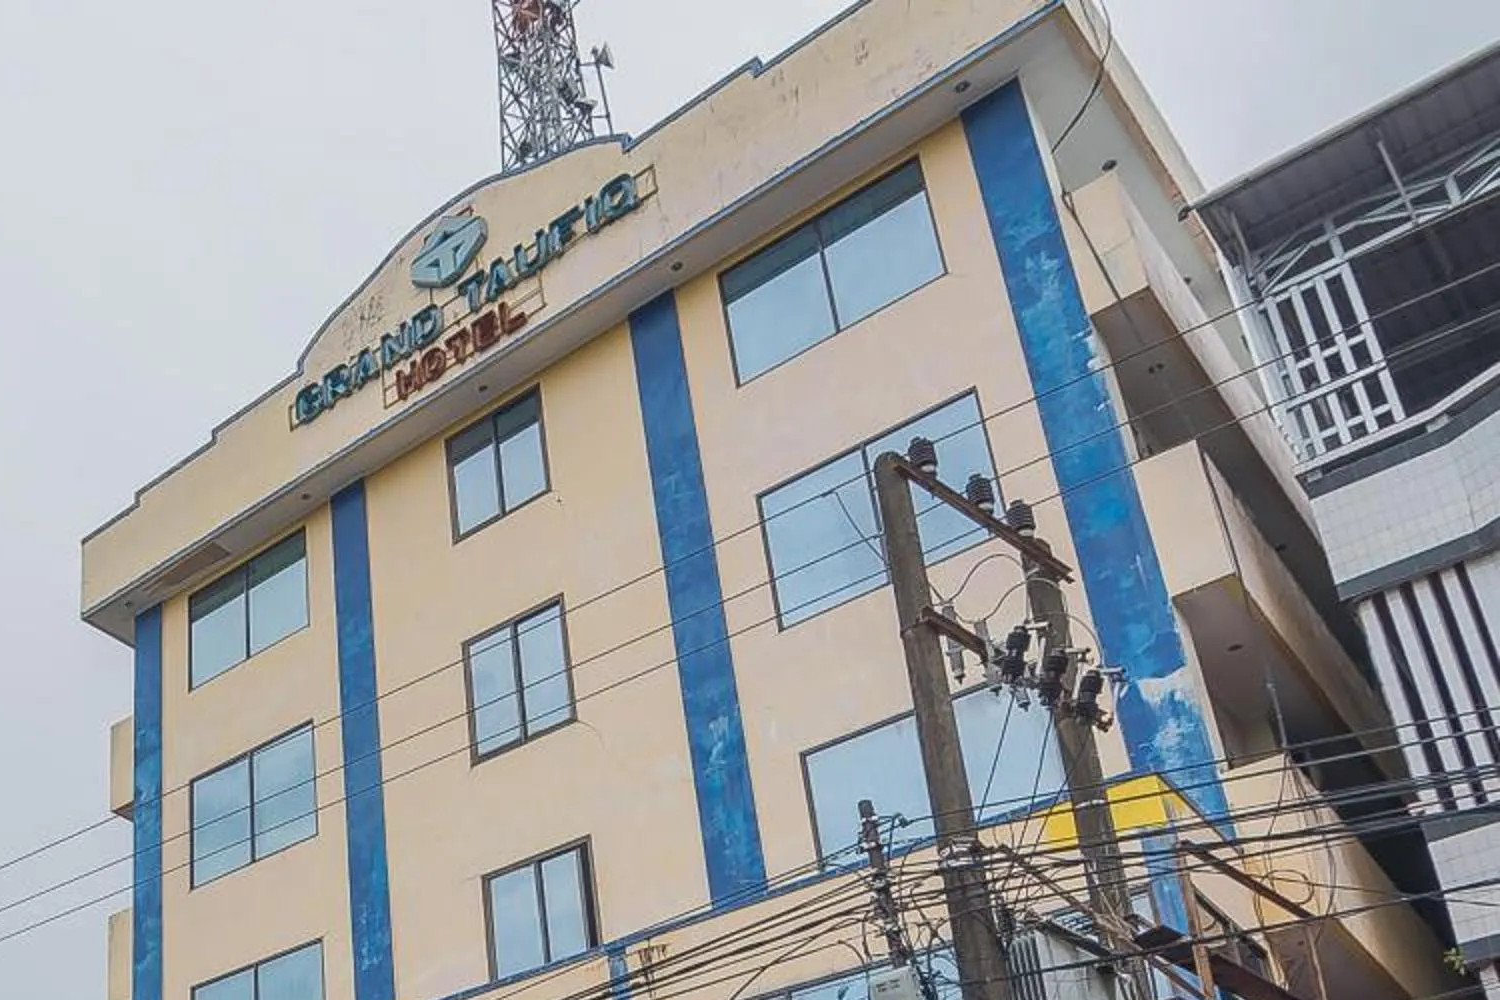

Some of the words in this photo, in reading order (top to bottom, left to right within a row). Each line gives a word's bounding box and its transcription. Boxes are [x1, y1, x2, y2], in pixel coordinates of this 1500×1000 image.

[296, 304, 444, 424] GRAND
[458, 173, 641, 313] TAUFIQ
[396, 302, 528, 400] HOTEL
